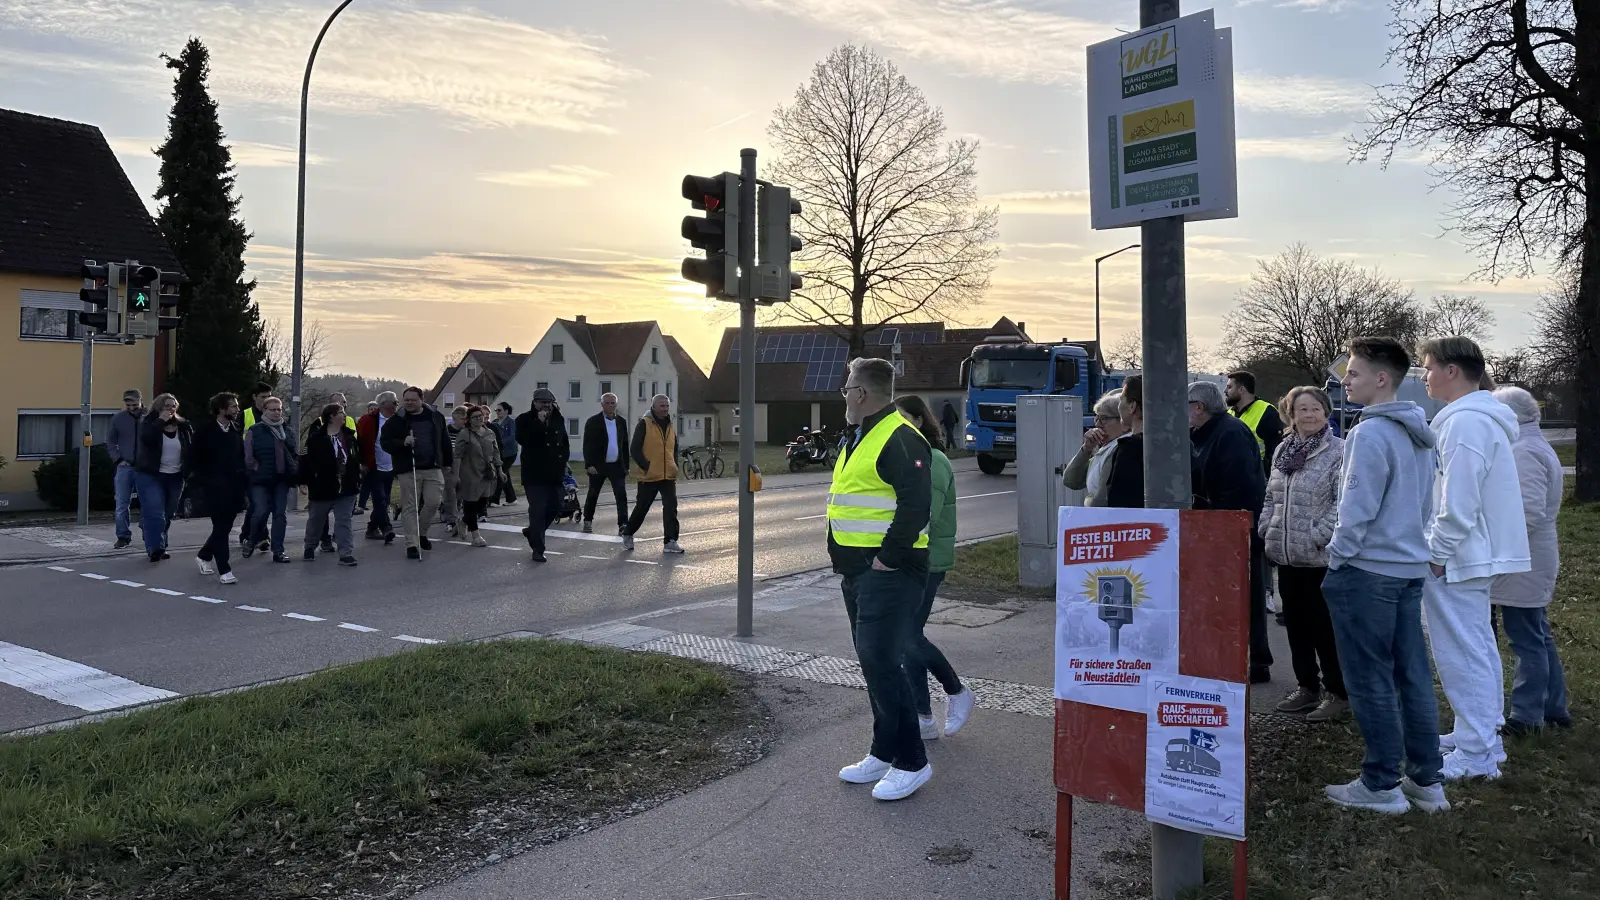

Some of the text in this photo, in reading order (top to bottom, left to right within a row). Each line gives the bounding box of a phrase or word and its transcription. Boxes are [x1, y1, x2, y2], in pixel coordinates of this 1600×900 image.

[1119, 32, 1179, 73] WGL
[1123, 67, 1175, 85] WÄHLERGRUPPE
[1124, 81, 1148, 94] LAND
[1127, 148, 1191, 167] ZUSAMMEN STARK!
[1132, 149, 1151, 158] LAND
[1070, 528, 1151, 545] FESTE BLITZER
[1069, 545, 1114, 560] JETZT!
[1069, 658, 1152, 670] Für sichere Straßen
[1074, 671, 1141, 683] in Neustädtlein
[1165, 686, 1221, 703] FERNVERKEHR
[1162, 714, 1222, 726] ORTSCHAFTEN!
[1190, 778, 1217, 790] Hauptstraße
